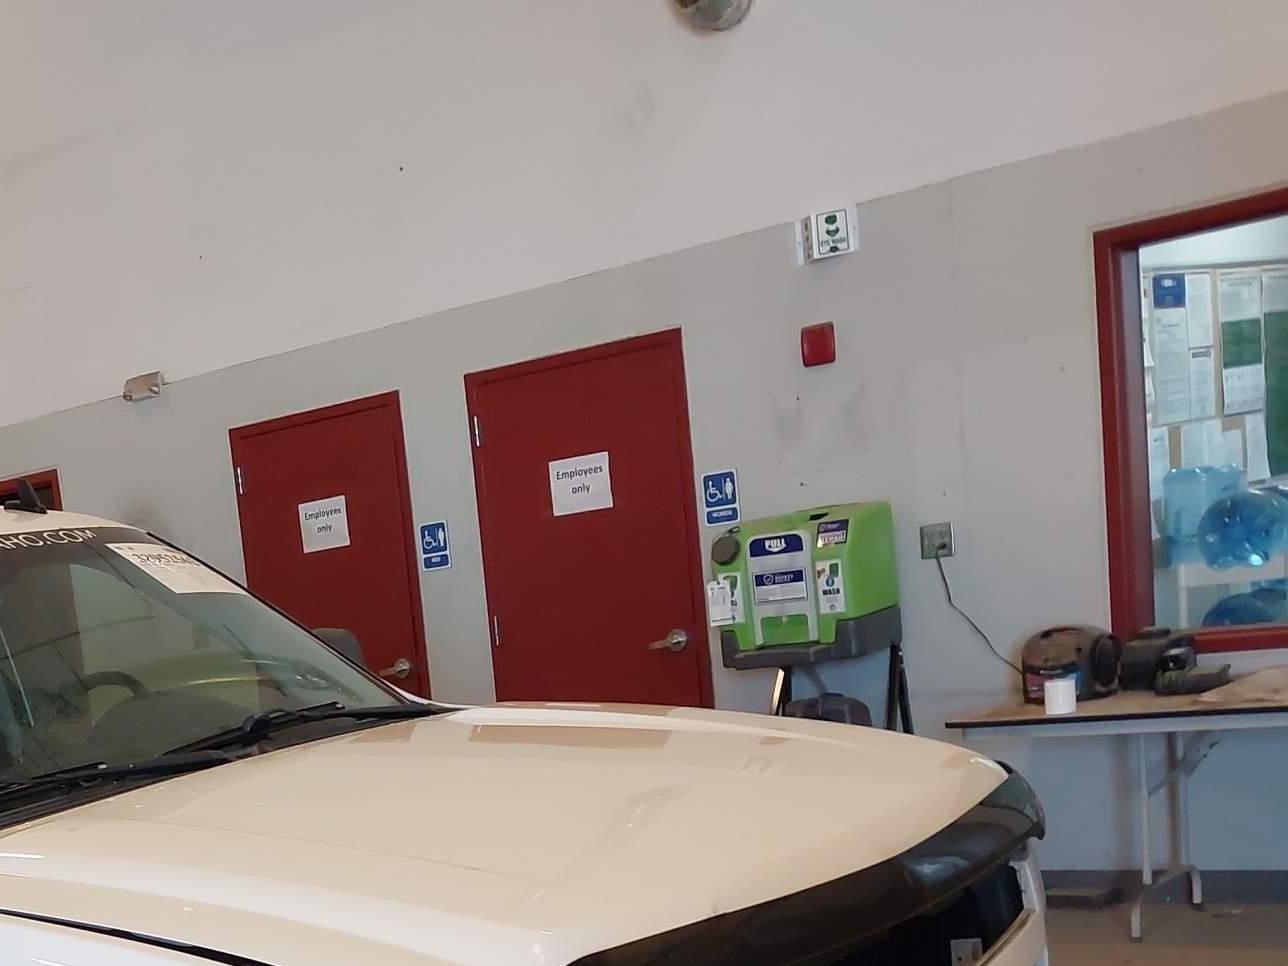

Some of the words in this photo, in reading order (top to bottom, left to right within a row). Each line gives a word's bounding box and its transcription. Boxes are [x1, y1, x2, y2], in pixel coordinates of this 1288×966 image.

[556, 464, 604, 481] Employees
[571, 482, 591, 495] only
[304, 506, 343, 521] Employees
[317, 523, 333, 534] only
[764, 538, 787, 549] PULL
[822, 587, 841, 596] WASH
